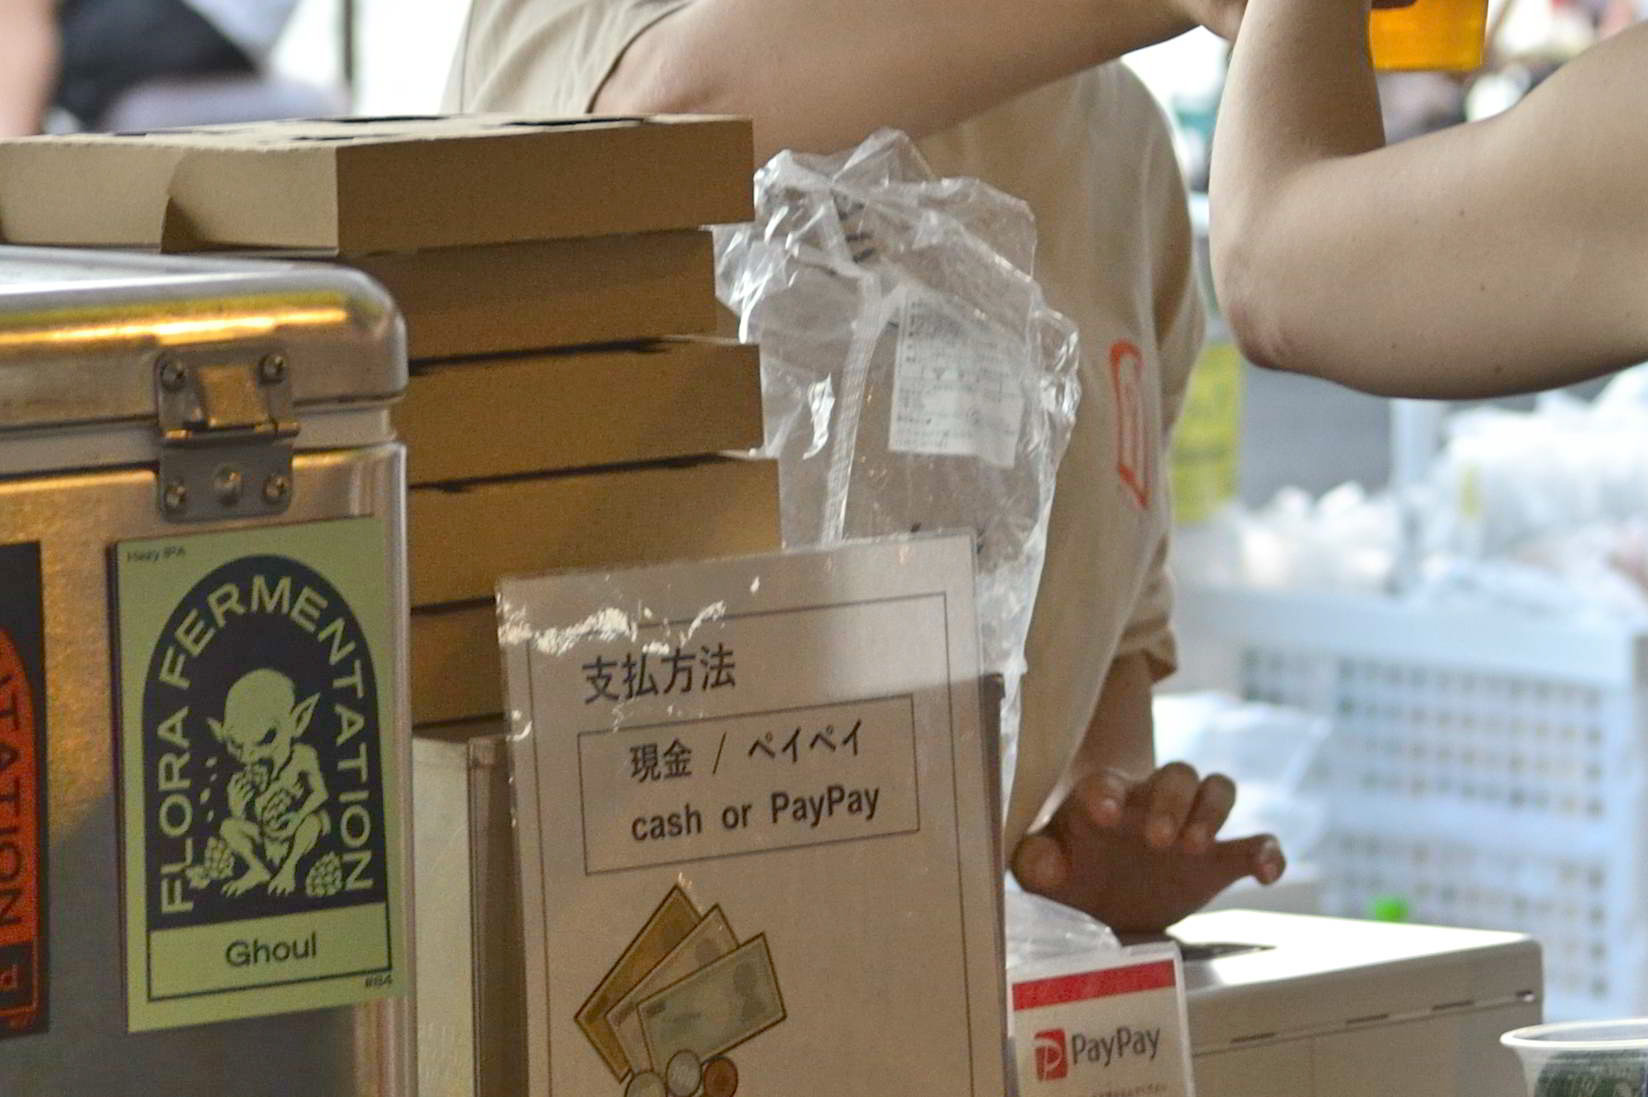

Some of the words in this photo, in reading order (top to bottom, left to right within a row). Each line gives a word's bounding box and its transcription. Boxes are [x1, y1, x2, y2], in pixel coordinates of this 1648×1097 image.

[582, 642, 737, 705] 支払方法
[158, 573, 374, 892] FERMENTATION
[629, 738, 693, 784] 現金
[747, 719, 863, 765] ペイペイ
[158, 705, 195, 914] FLORA
[631, 803, 703, 842] cash
[721, 800, 753, 832] or
[770, 784, 880, 825] PayPay
[224, 932, 319, 969] Ghoul
[1071, 1027, 1161, 1068] PayPay
